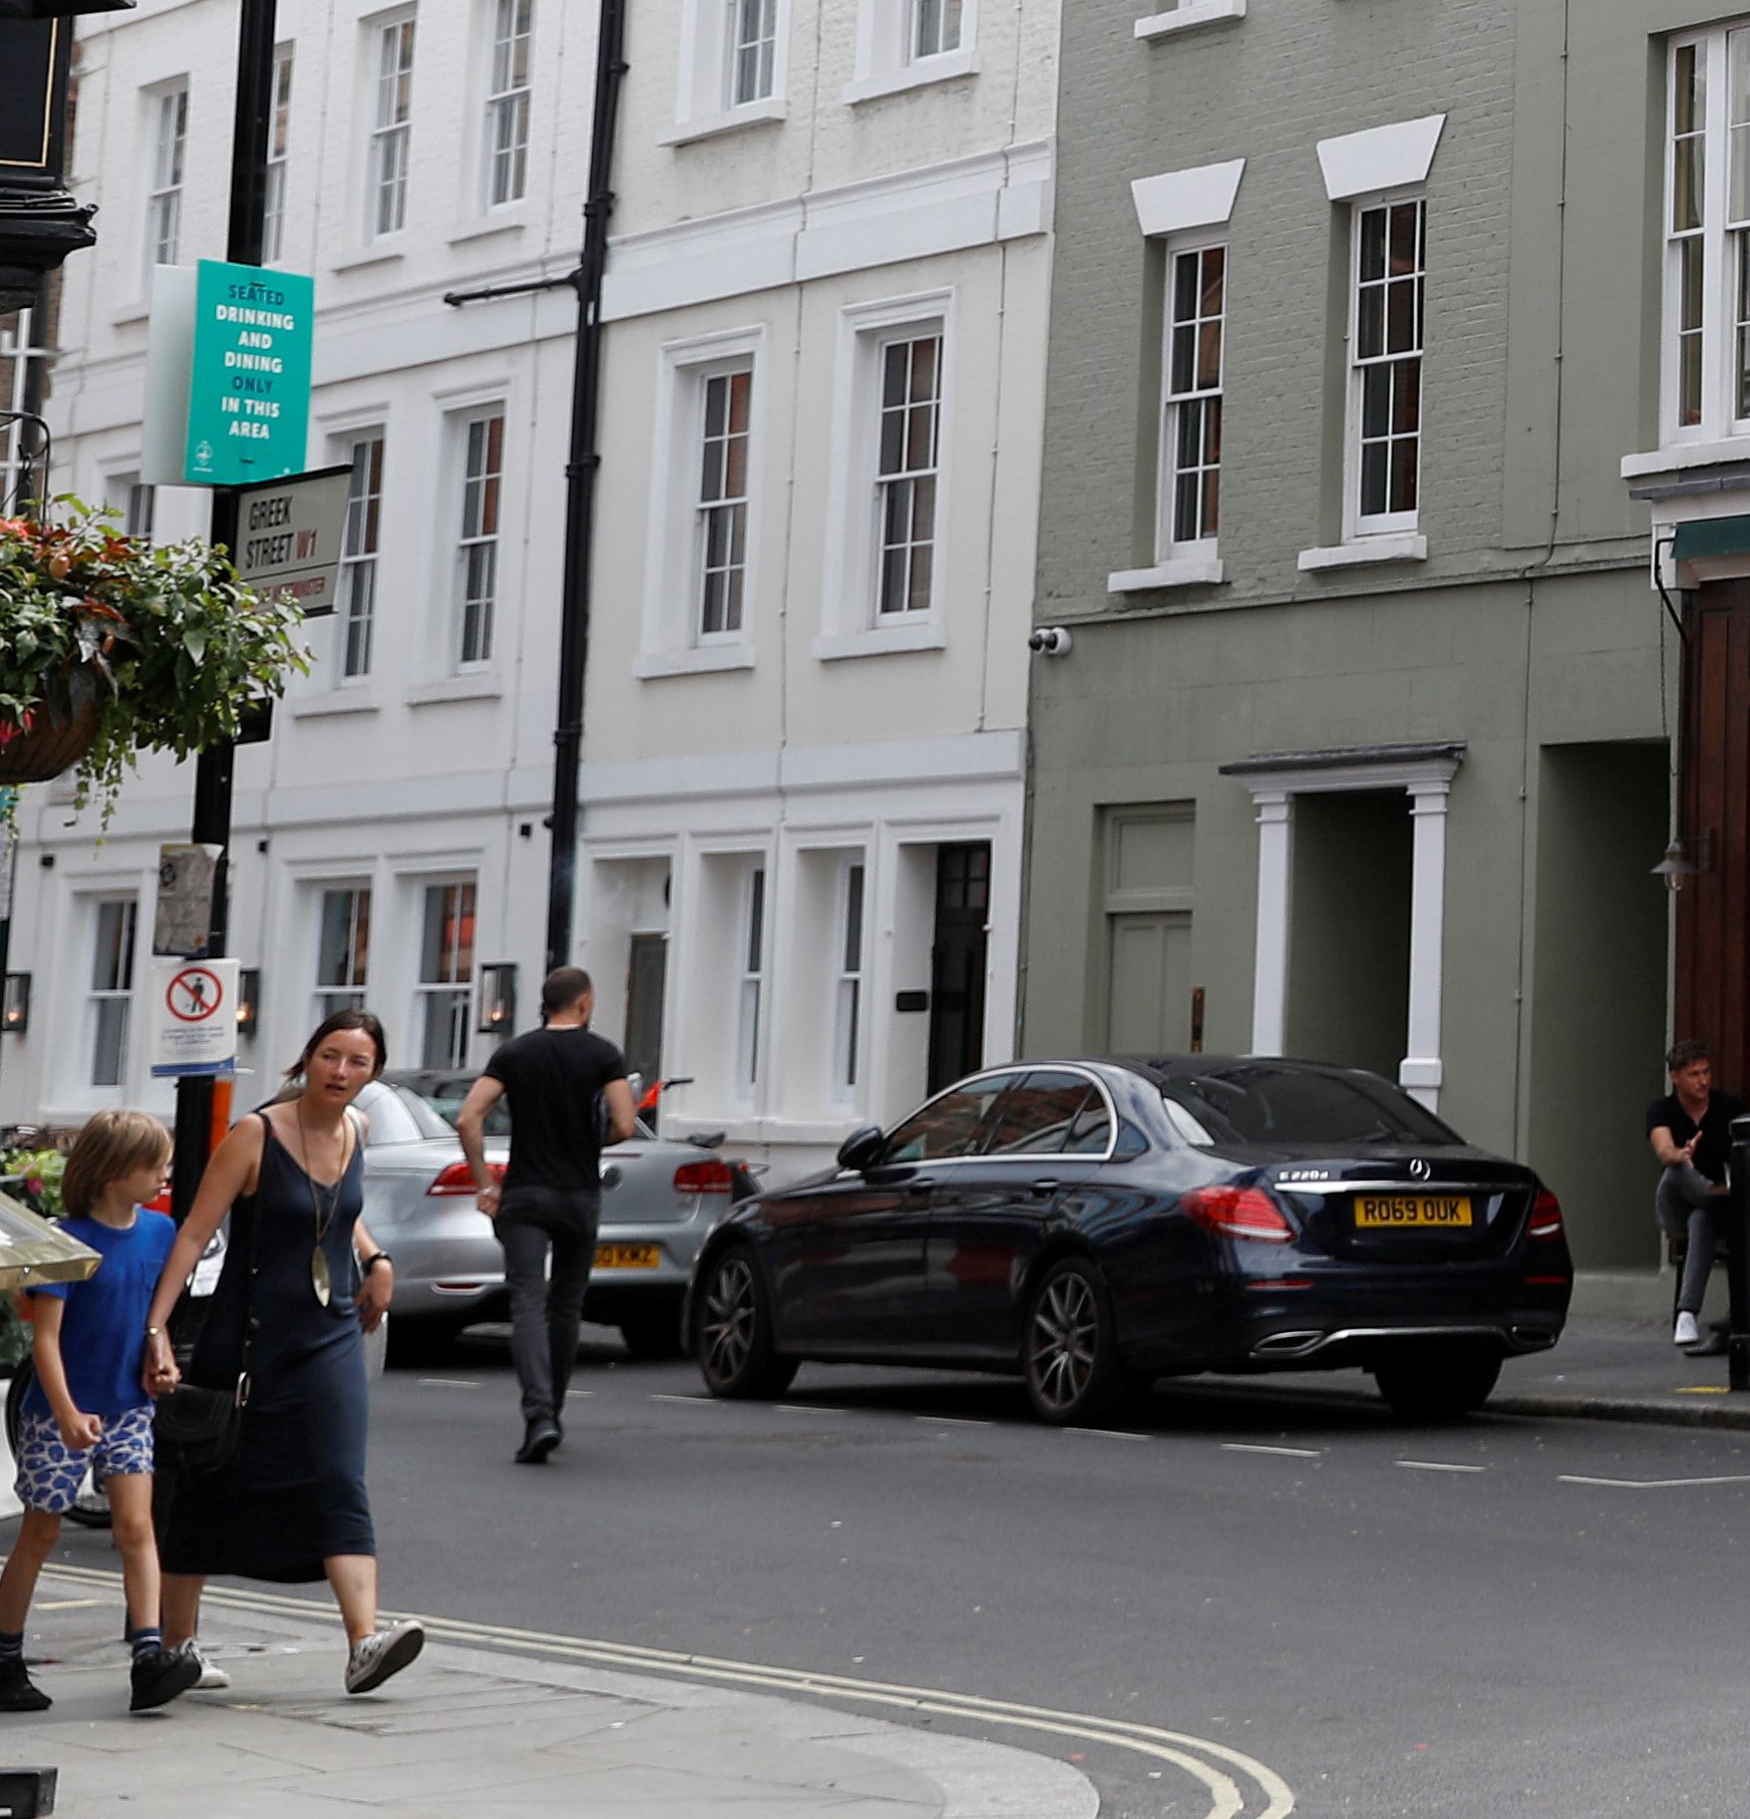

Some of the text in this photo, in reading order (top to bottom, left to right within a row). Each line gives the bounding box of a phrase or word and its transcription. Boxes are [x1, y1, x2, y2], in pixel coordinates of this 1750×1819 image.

[228, 284, 285, 307] SEATED
[215, 304, 295, 331] DRINKING
[238, 330, 273, 350] AND
[224, 350, 283, 373] DINING
[231, 375, 274, 394] ONLY
[220, 396, 280, 418] IN THIS
[228, 420, 271, 440] AREA
[249, 495, 293, 531] GREEK
[245, 530, 318, 569] STREET W1
[1364, 1198, 1461, 1222] RO69 OUK
